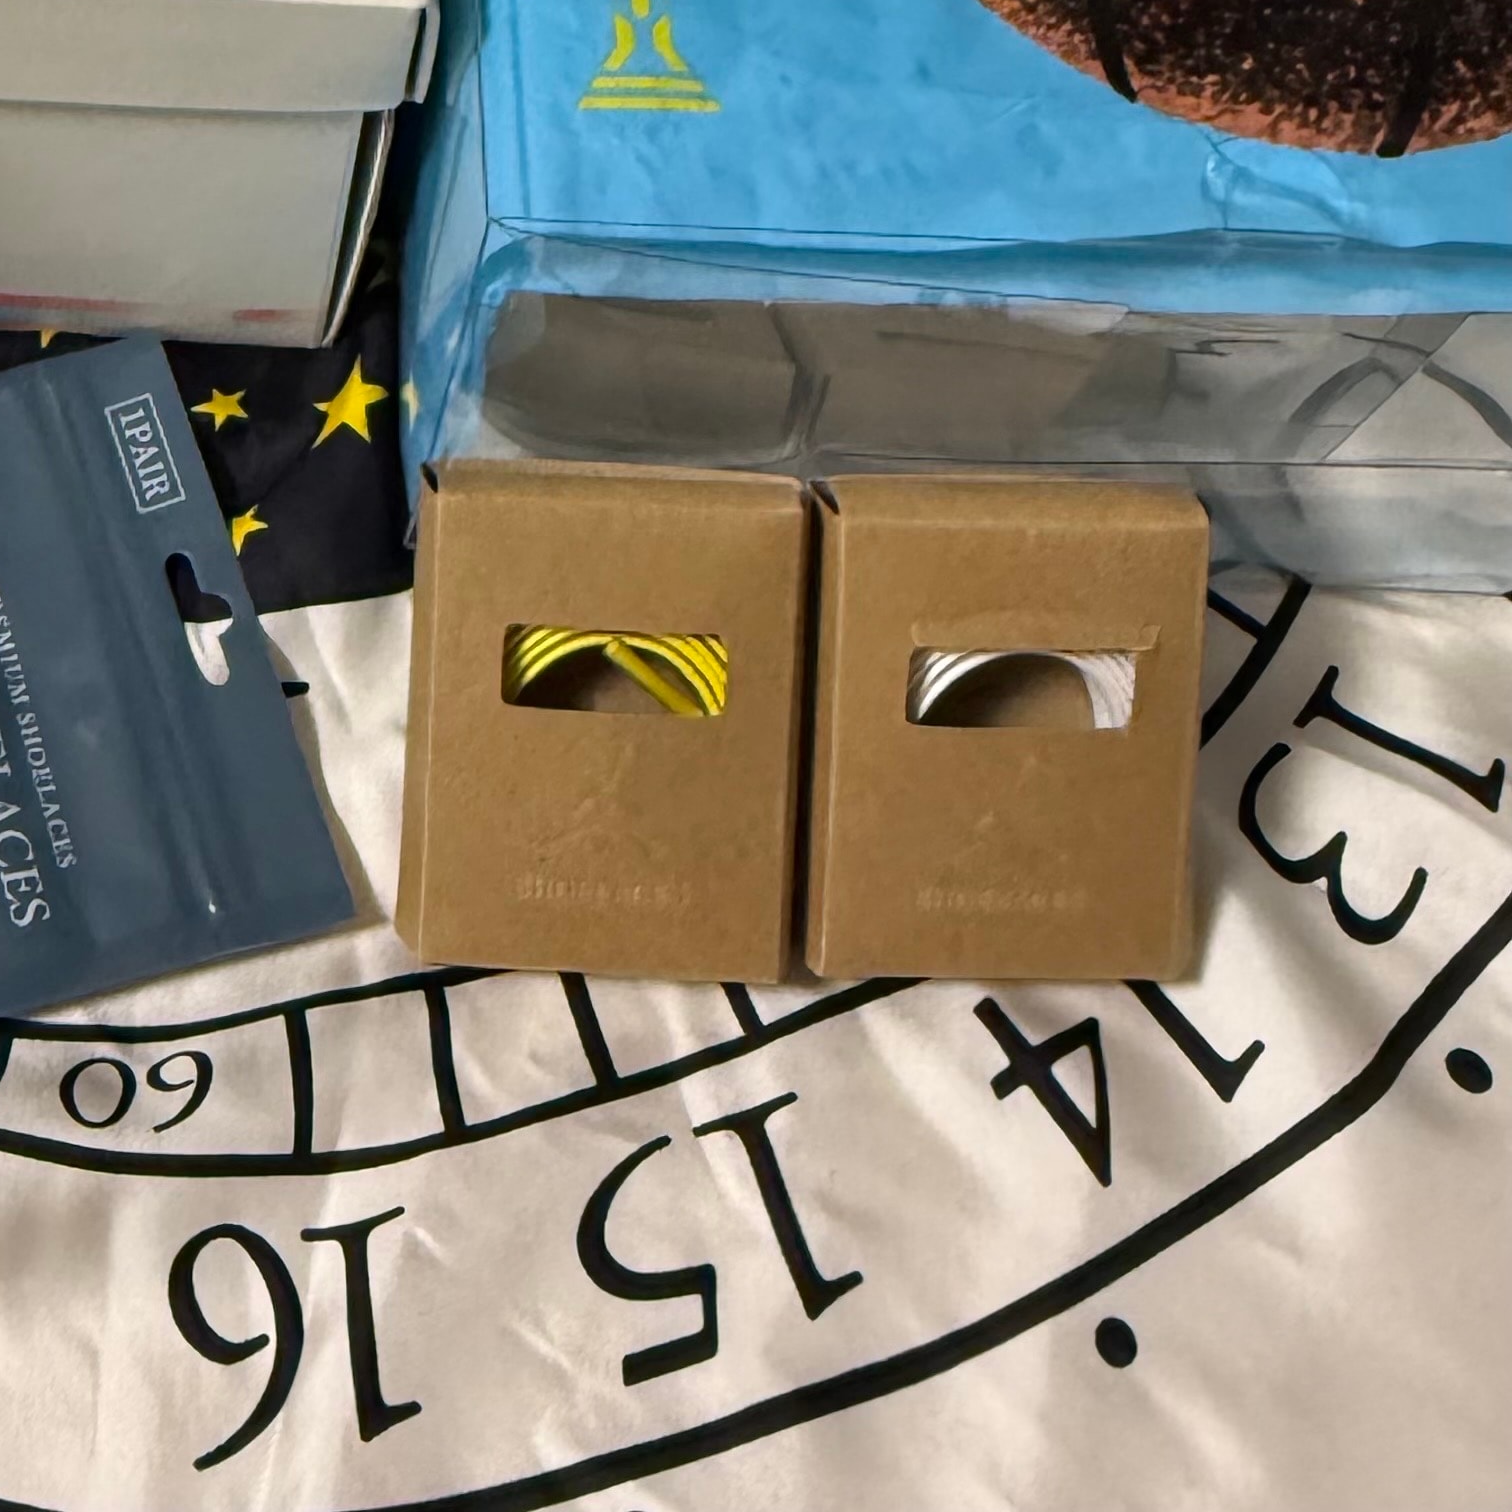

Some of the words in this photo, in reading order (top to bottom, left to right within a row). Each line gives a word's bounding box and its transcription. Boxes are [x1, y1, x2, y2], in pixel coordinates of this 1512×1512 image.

[15, 711, 78, 870] SHOELACES
[1238, 663, 1506, 946] 13
[59, 1049, 213, 1134] 60
[972, 981, 1266, 1186] 14
[167, 1206, 422, 1470] 16
[576, 1091, 864, 1387] 15
